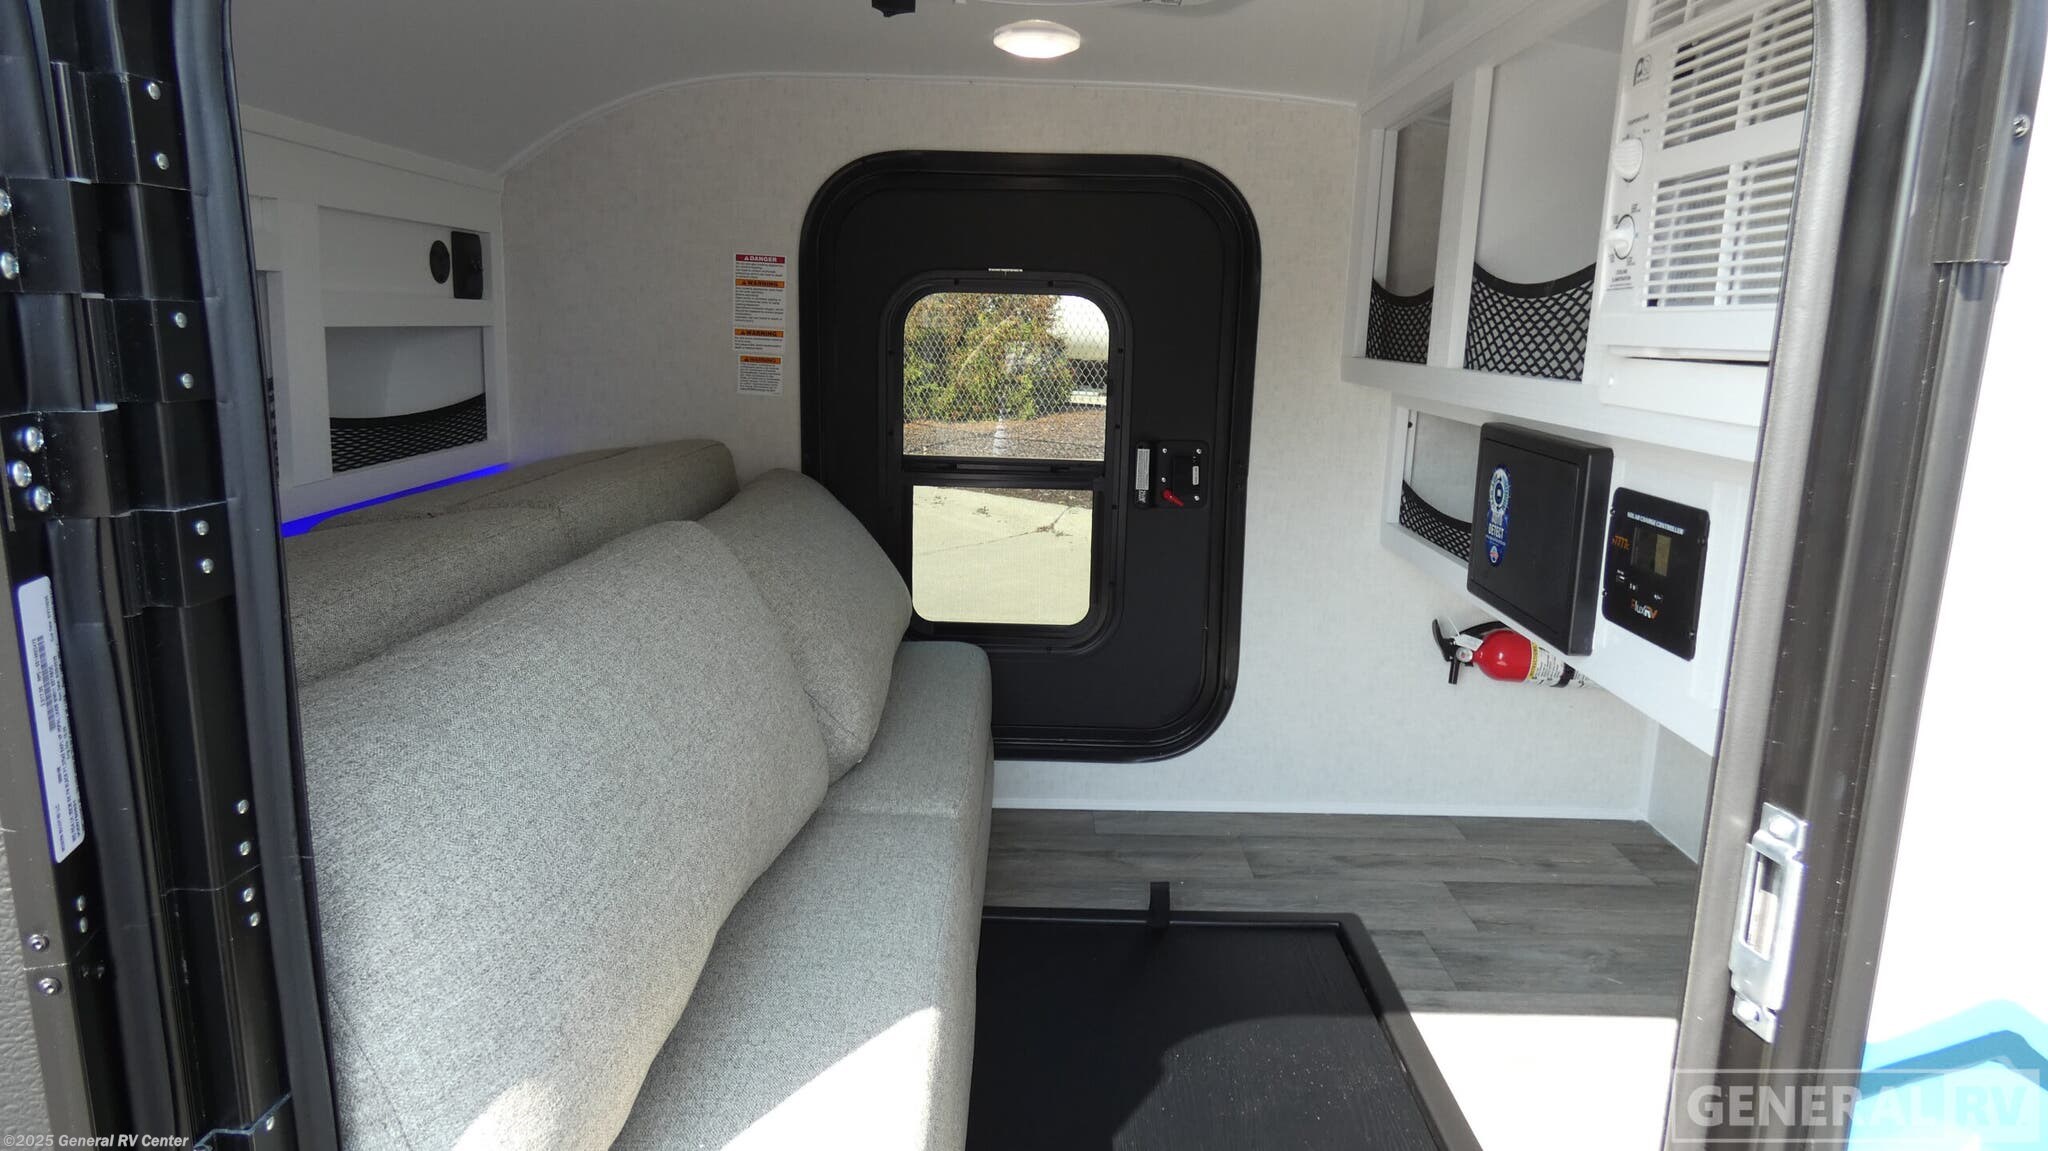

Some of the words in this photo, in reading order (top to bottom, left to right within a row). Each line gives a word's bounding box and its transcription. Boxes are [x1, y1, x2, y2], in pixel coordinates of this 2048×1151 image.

[746, 329, 777, 337] WARNING
[1488, 522, 1504, 540] DETECT
[1656, 520, 1685, 536] CONTROLLER
